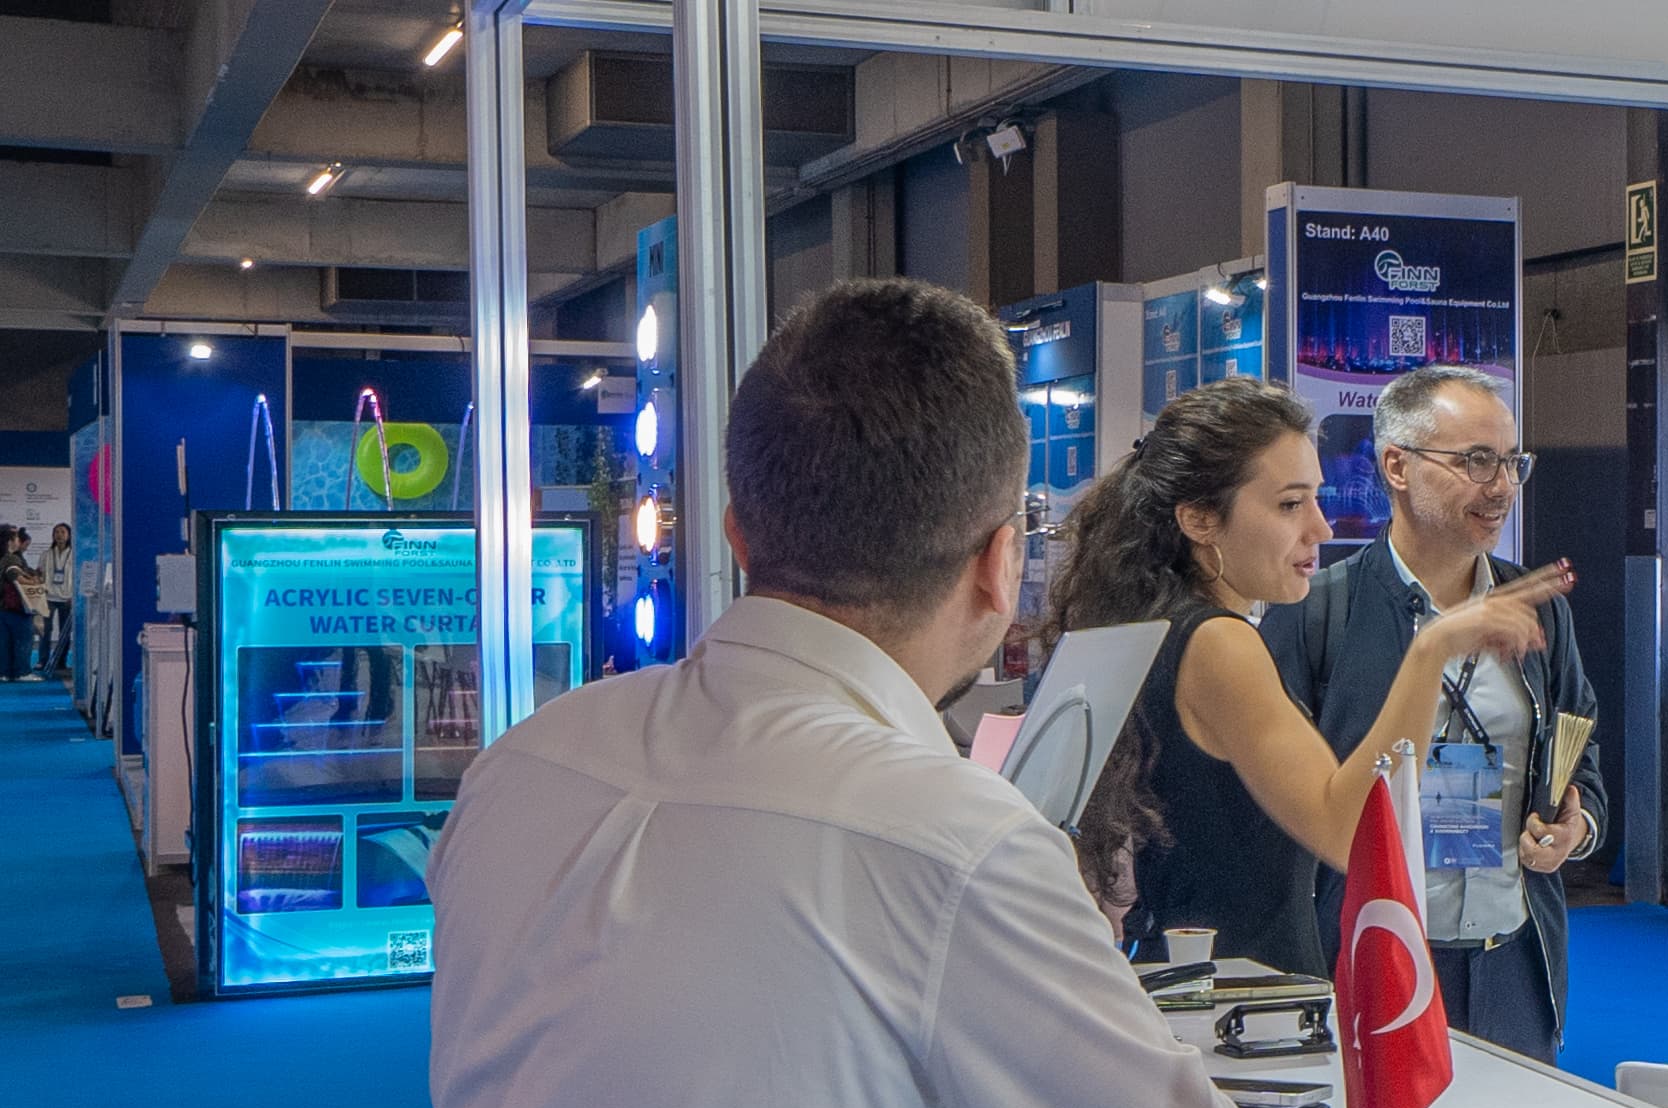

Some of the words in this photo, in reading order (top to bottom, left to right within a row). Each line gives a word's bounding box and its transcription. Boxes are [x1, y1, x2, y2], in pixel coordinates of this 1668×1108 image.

[1305, 223, 1356, 240] Stand:
[1359, 226, 1389, 241] A40
[1387, 265, 1440, 281] FINN
[1389, 280, 1440, 291] FORST
[231, 559, 300, 568] GUANGZHOU
[304, 559, 341, 568] FENLIN
[344, 559, 399, 568] SWIMMING
[265, 588, 369, 607] ACRYLIC
[377, 588, 546, 606] SEVEN-CR
[310, 615, 396, 634] WATER
